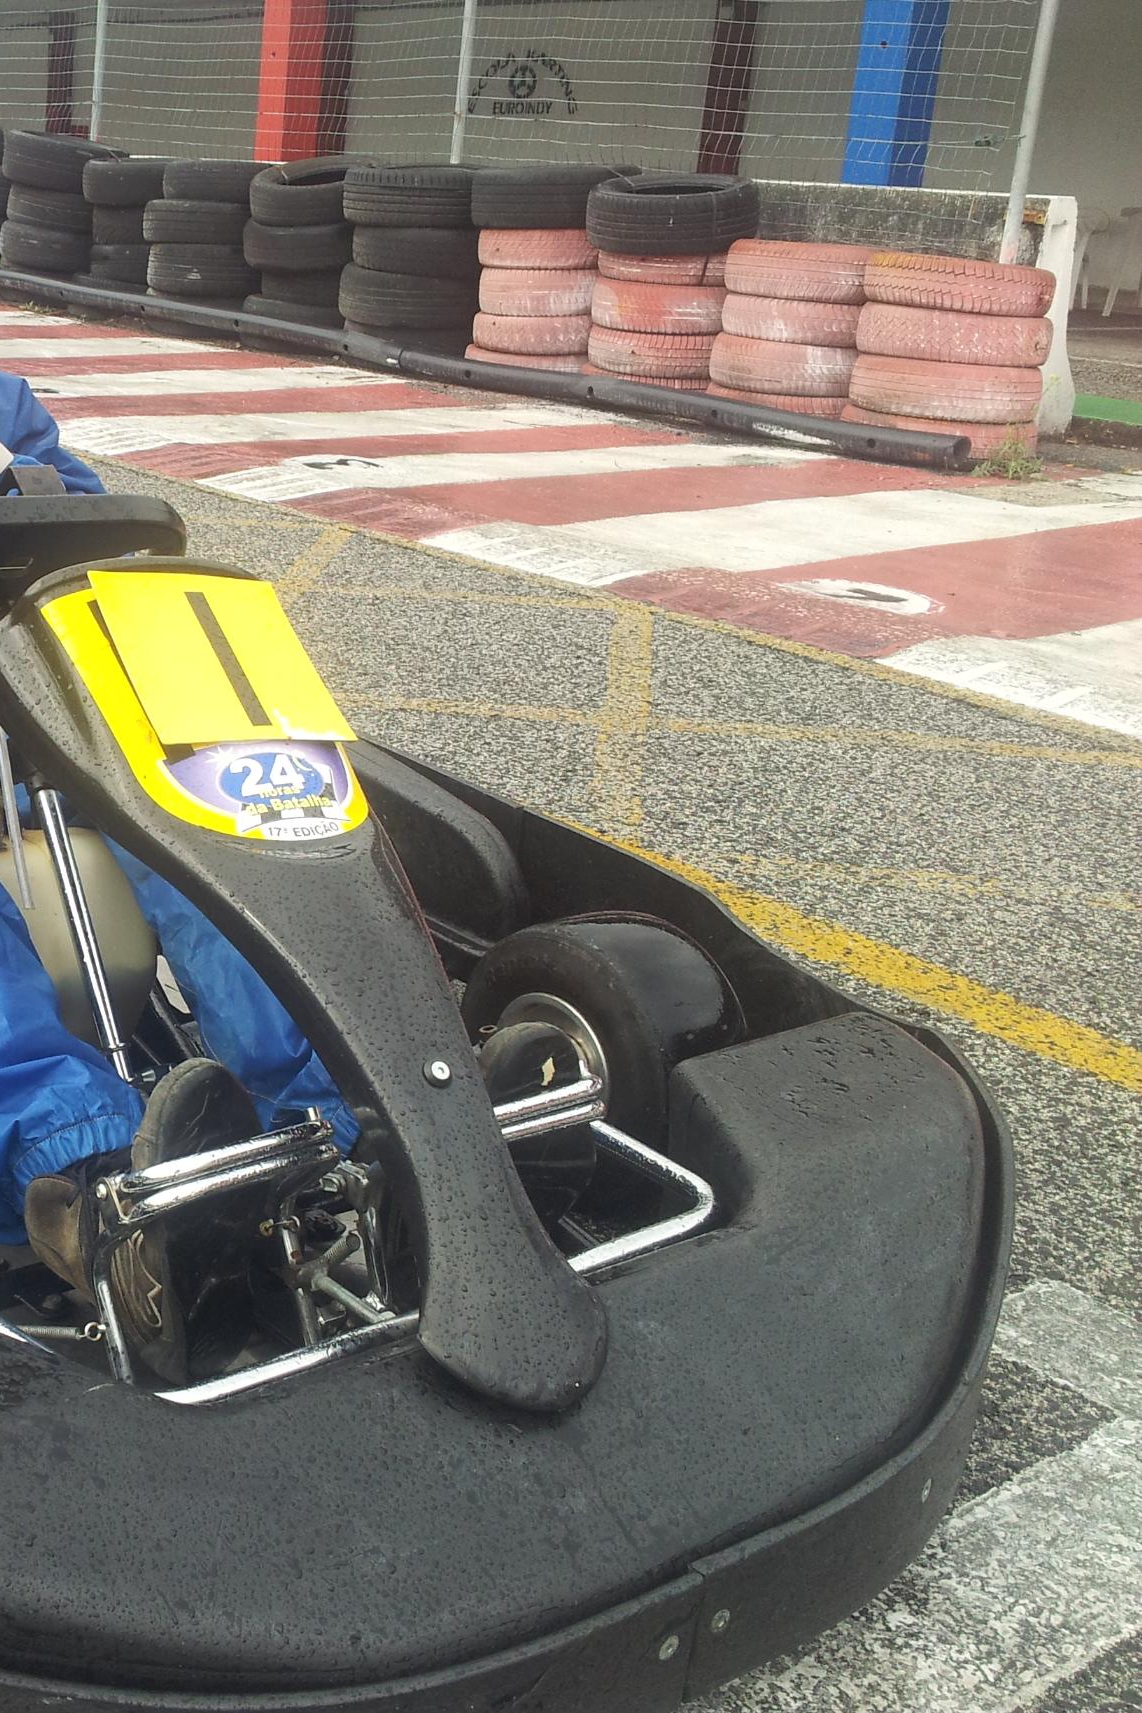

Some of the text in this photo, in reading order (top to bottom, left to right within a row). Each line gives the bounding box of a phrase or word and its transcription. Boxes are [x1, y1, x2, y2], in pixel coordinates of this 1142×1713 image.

[492, 101, 552, 115] EUROINDY
[184, 591, 272, 726] 1
[229, 754, 305, 797] 24
[246, 794, 333, 816] da Batalha
[292, 820, 339, 837] EDIÇÃO
